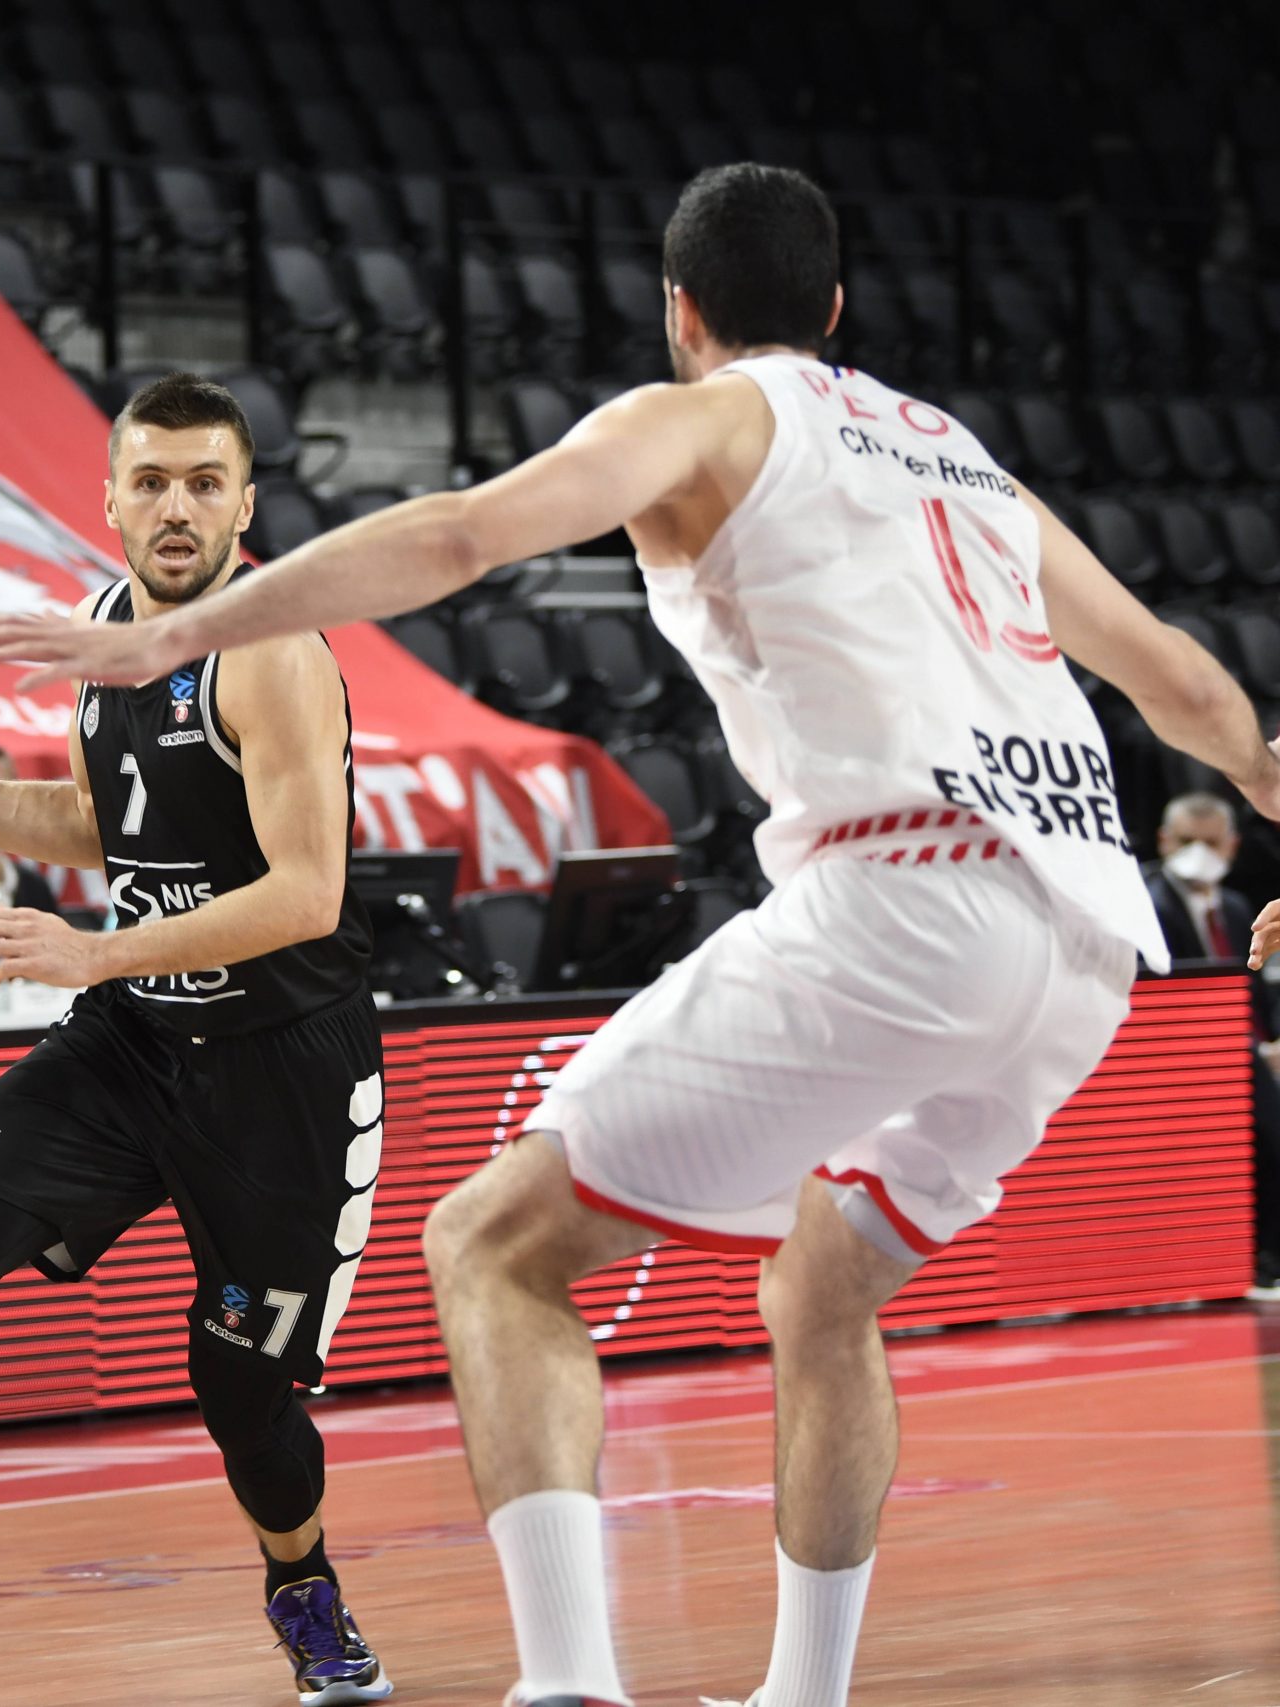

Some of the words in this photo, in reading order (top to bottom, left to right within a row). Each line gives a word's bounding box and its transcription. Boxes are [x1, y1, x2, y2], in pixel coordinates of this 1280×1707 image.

[937, 455, 1018, 498] Rema
[120, 753, 147, 835] 7
[161, 882, 216, 910] NIS
[204, 1319, 253, 1348] oneteam
[259, 1287, 308, 1358] 7
